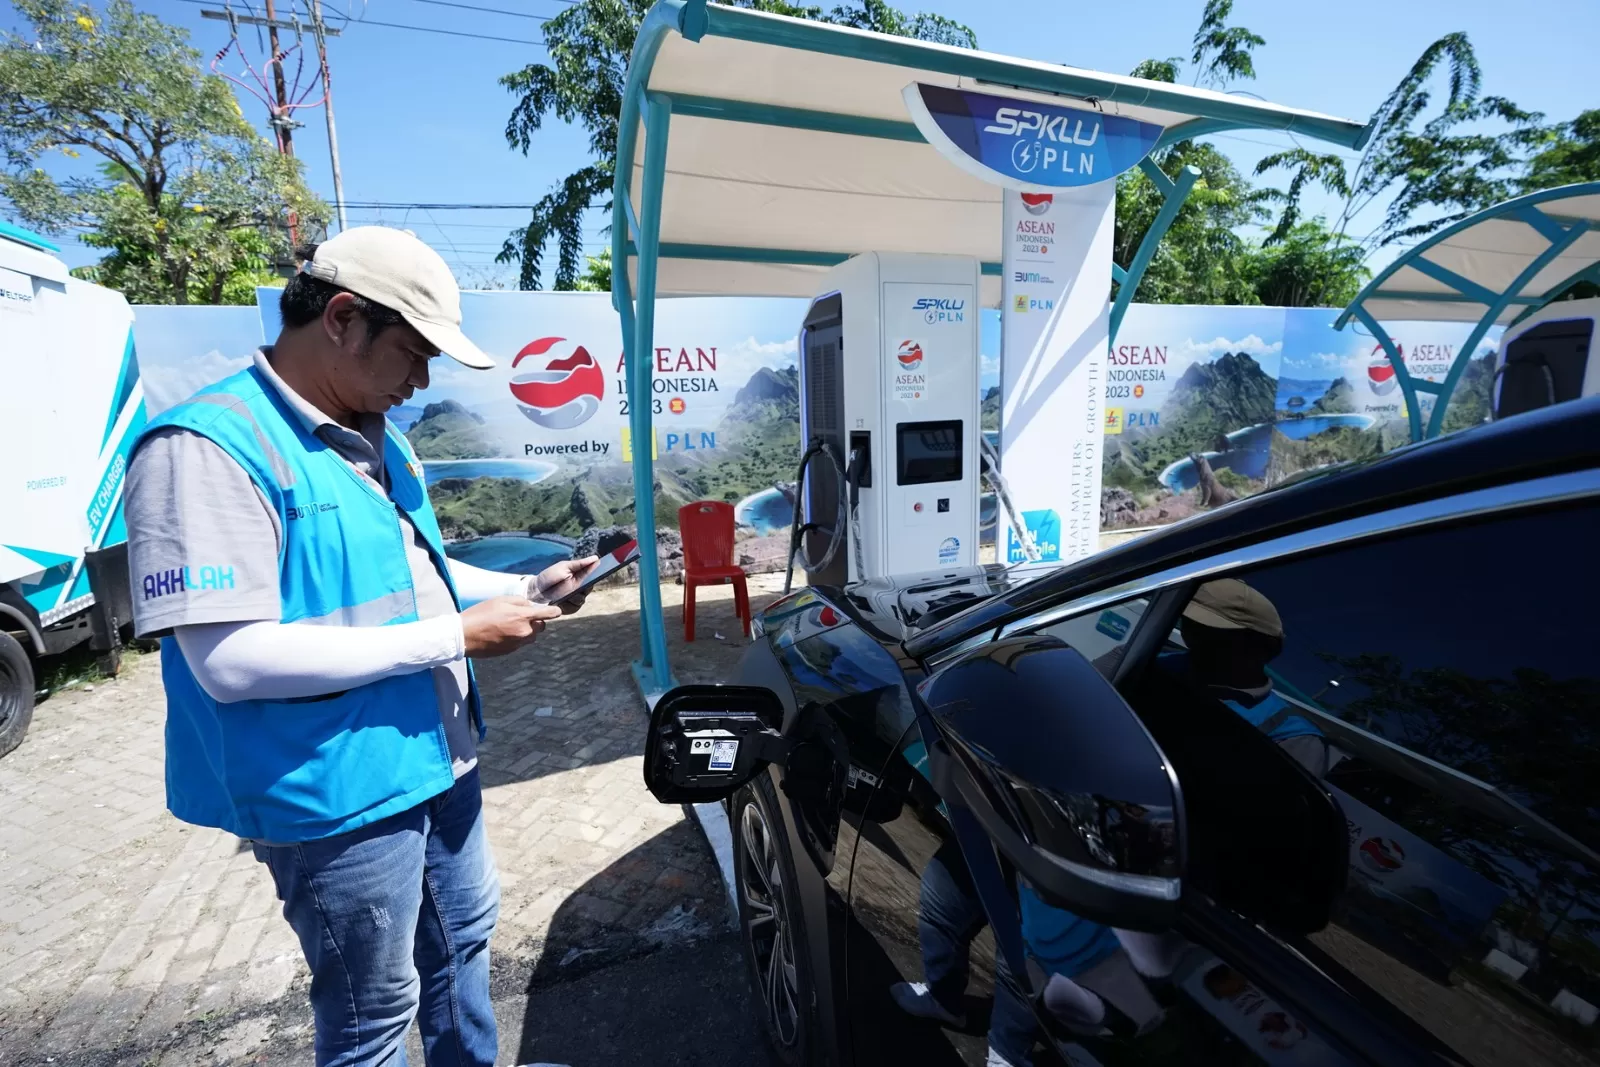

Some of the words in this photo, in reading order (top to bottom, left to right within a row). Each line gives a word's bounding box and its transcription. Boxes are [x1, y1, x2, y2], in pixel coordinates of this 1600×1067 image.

[984, 107, 1100, 147] SPKLU
[1043, 147, 1095, 175] PLN
[1016, 220, 1055, 235] ASEAN
[1016, 234, 1055, 244] INDONESIA
[1022, 244, 1039, 253] 2023
[912, 298, 964, 310] SPKLU
[1030, 299, 1053, 310] PLN
[938, 312, 963, 322] PLN
[616, 347, 717, 373] AEAN
[1410, 344, 1453, 361] ASEAN
[895, 375, 925, 384] ASEAN
[1108, 369, 1166, 382] NDONESIA
[616, 377, 719, 394] IONESIA
[1105, 385, 1130, 398] 2023
[1086, 362, 1098, 433] GROWTH
[619, 399, 663, 415] 23
[1128, 412, 1159, 427] PLN
[524, 440, 590, 456] Powered
[592, 440, 610, 454] by
[666, 432, 716, 451] PLN
[1085, 441, 1094, 460] OF
[26, 478, 58, 491] POWERED
[60, 476, 67, 486] BY
[89, 507, 103, 527] EV
[97, 453, 126, 508] CHARGER
[1011, 530, 1037, 545] PN
[1011, 540, 1056, 560] mbile
[143, 565, 235, 600] AKHLAK
